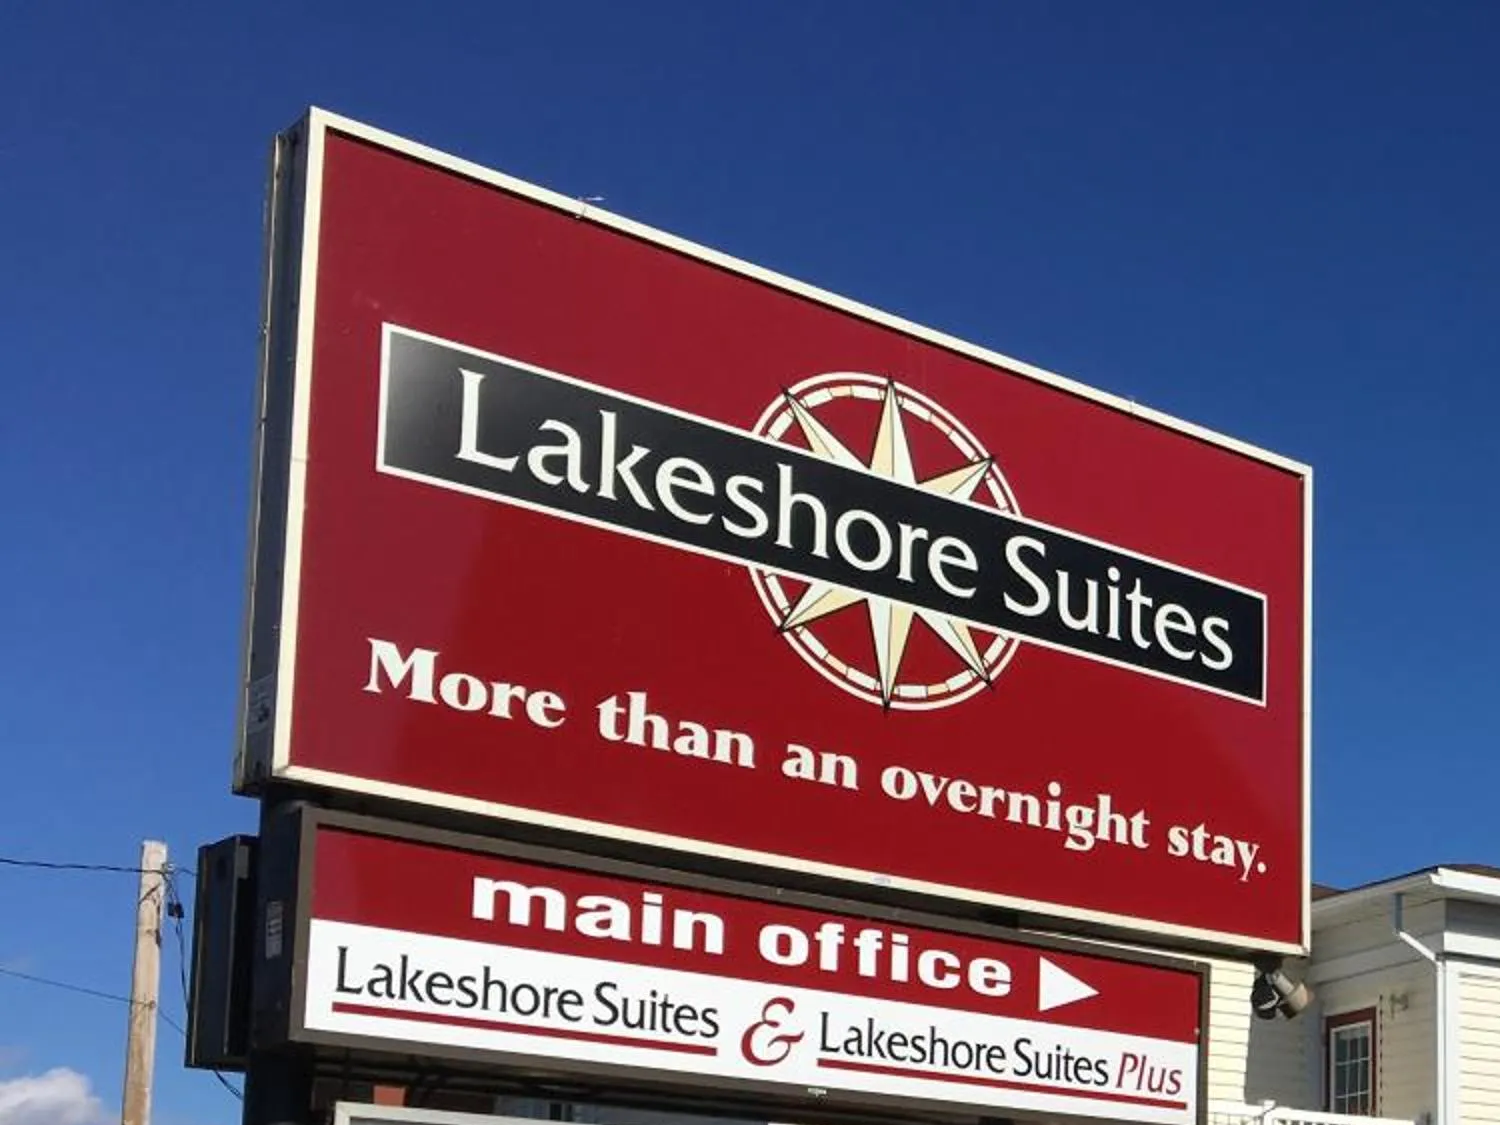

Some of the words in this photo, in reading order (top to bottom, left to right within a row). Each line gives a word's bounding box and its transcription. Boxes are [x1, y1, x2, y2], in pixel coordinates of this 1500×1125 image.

[454, 366, 981, 599] Lakeshore
[1002, 534, 1234, 672] Suites
[362, 636, 567, 729] More
[595, 690, 756, 770] than
[780, 742, 859, 791] an
[880, 765, 1151, 852] overnight
[1166, 822, 1268, 882] stay.
[335, 945, 584, 1023] Lakeshore
[592, 980, 720, 1040] Suites
[740, 994, 802, 1068] &
[819, 1010, 1007, 1075] Lakeshore
[1012, 1036, 1110, 1087] Suites
[1113, 1049, 1185, 1097] Plus
[471, 875, 726, 956] main
[757, 921, 1013, 998] office
